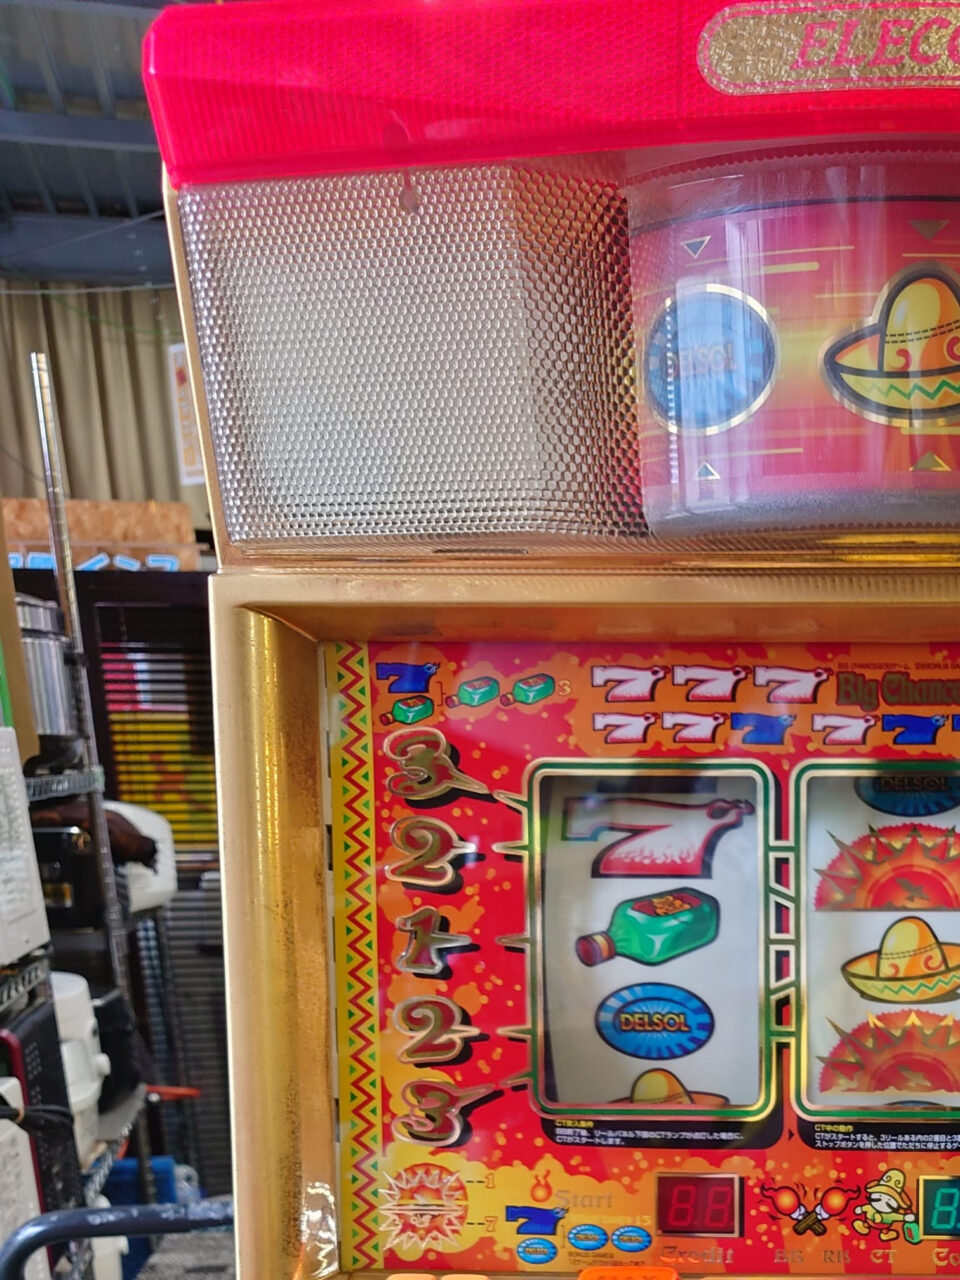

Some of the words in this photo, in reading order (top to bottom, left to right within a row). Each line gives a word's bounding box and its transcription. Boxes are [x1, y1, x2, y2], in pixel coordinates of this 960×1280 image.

[558, 680, 572, 696] 3
[836, 671, 880, 711] Big
[384, 726, 470, 797] 3
[385, 815, 465, 886] 2
[561, 797, 755, 879] 7
[396, 905, 456, 974] 1
[392, 996, 468, 1063] 2
[619, 1013, 690, 1032] DELSOL
[391, 1079, 476, 1146] 3
[556, 1189, 612, 1208] Start
[485, 1216, 498, 1232] 7
[660, 1246, 734, 1264] Credit
[871, 1248, 897, 1264] CT
